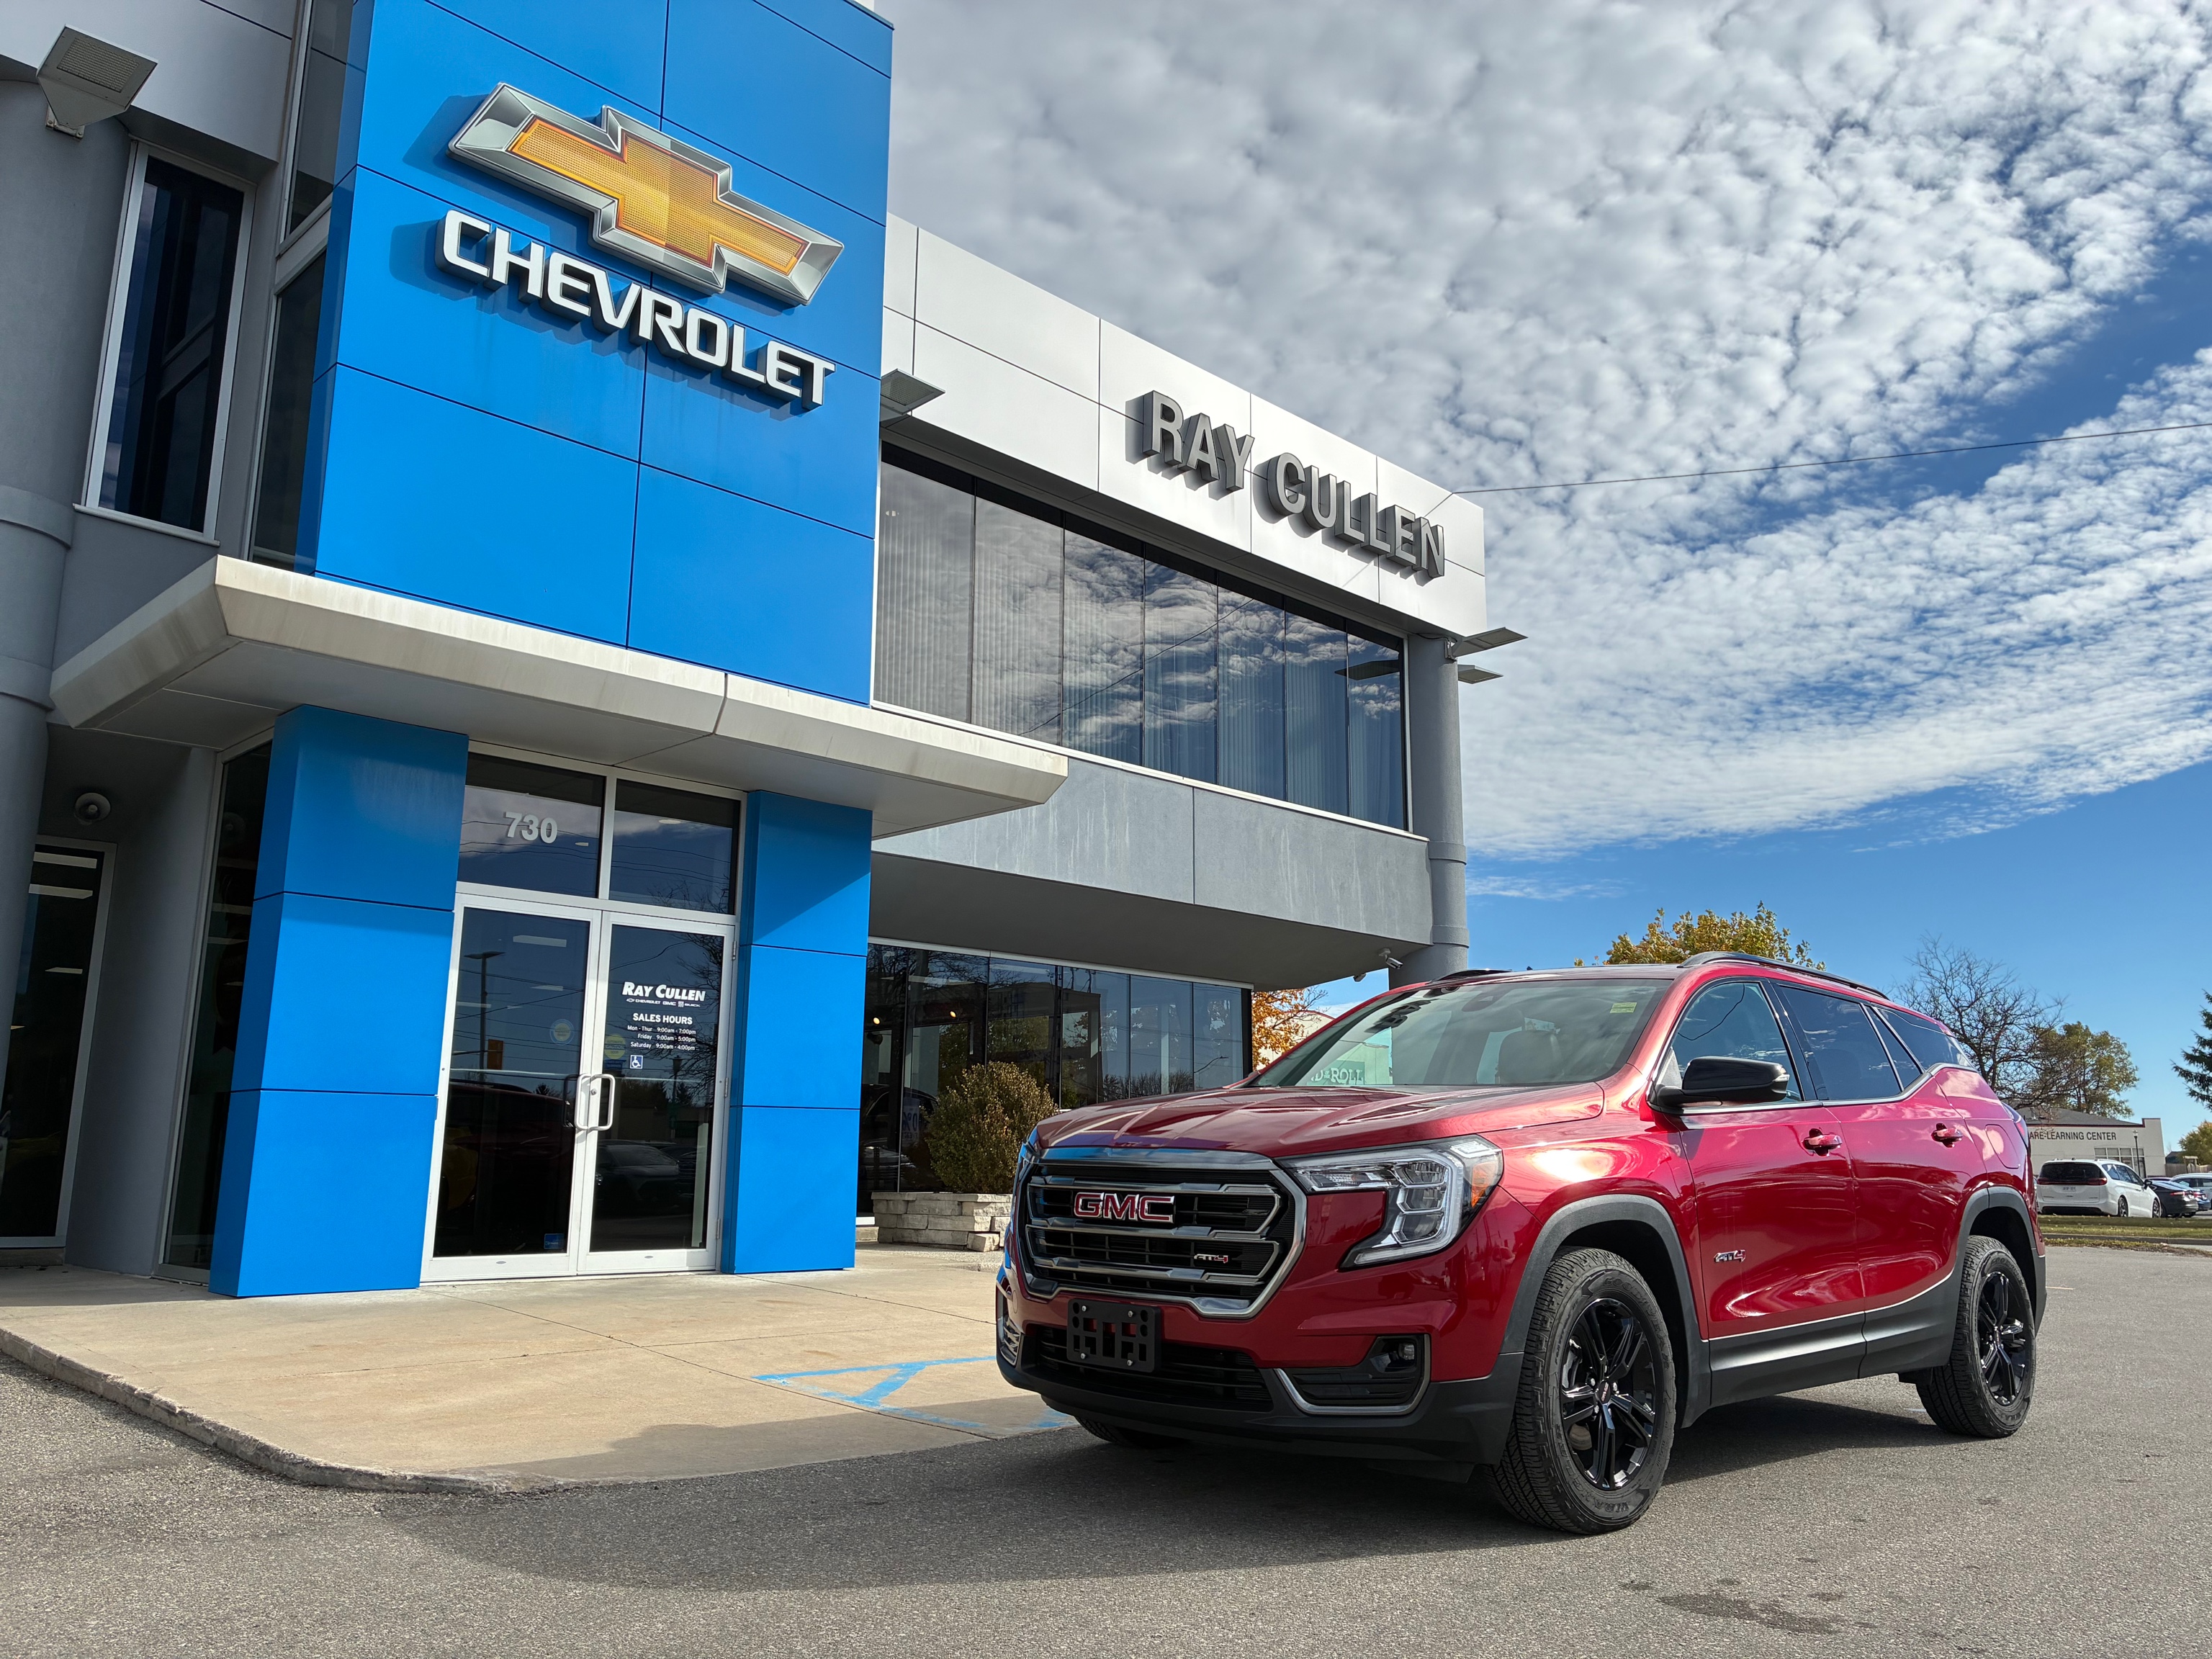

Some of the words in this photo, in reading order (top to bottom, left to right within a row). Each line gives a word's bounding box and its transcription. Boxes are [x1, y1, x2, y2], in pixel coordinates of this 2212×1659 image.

[436, 210, 836, 410] CHEVROLET
[1143, 390, 1255, 491] RAY
[1267, 452, 1444, 578] CULLEN
[505, 811, 557, 843] 730
[622, 981, 654, 997] RAY
[655, 984, 706, 1001] CULLEN
[633, 1012, 661, 1022] SALES
[662, 1015, 693, 1025] HOURS
[1331, 1068, 1364, 1085] ROLL
[2086, 1132, 2116, 1141] CENTER
[1074, 1192, 1175, 1223] GMC
[1193, 1253, 1228, 1263] AT4
[1714, 1249, 1746, 1262] AT4
